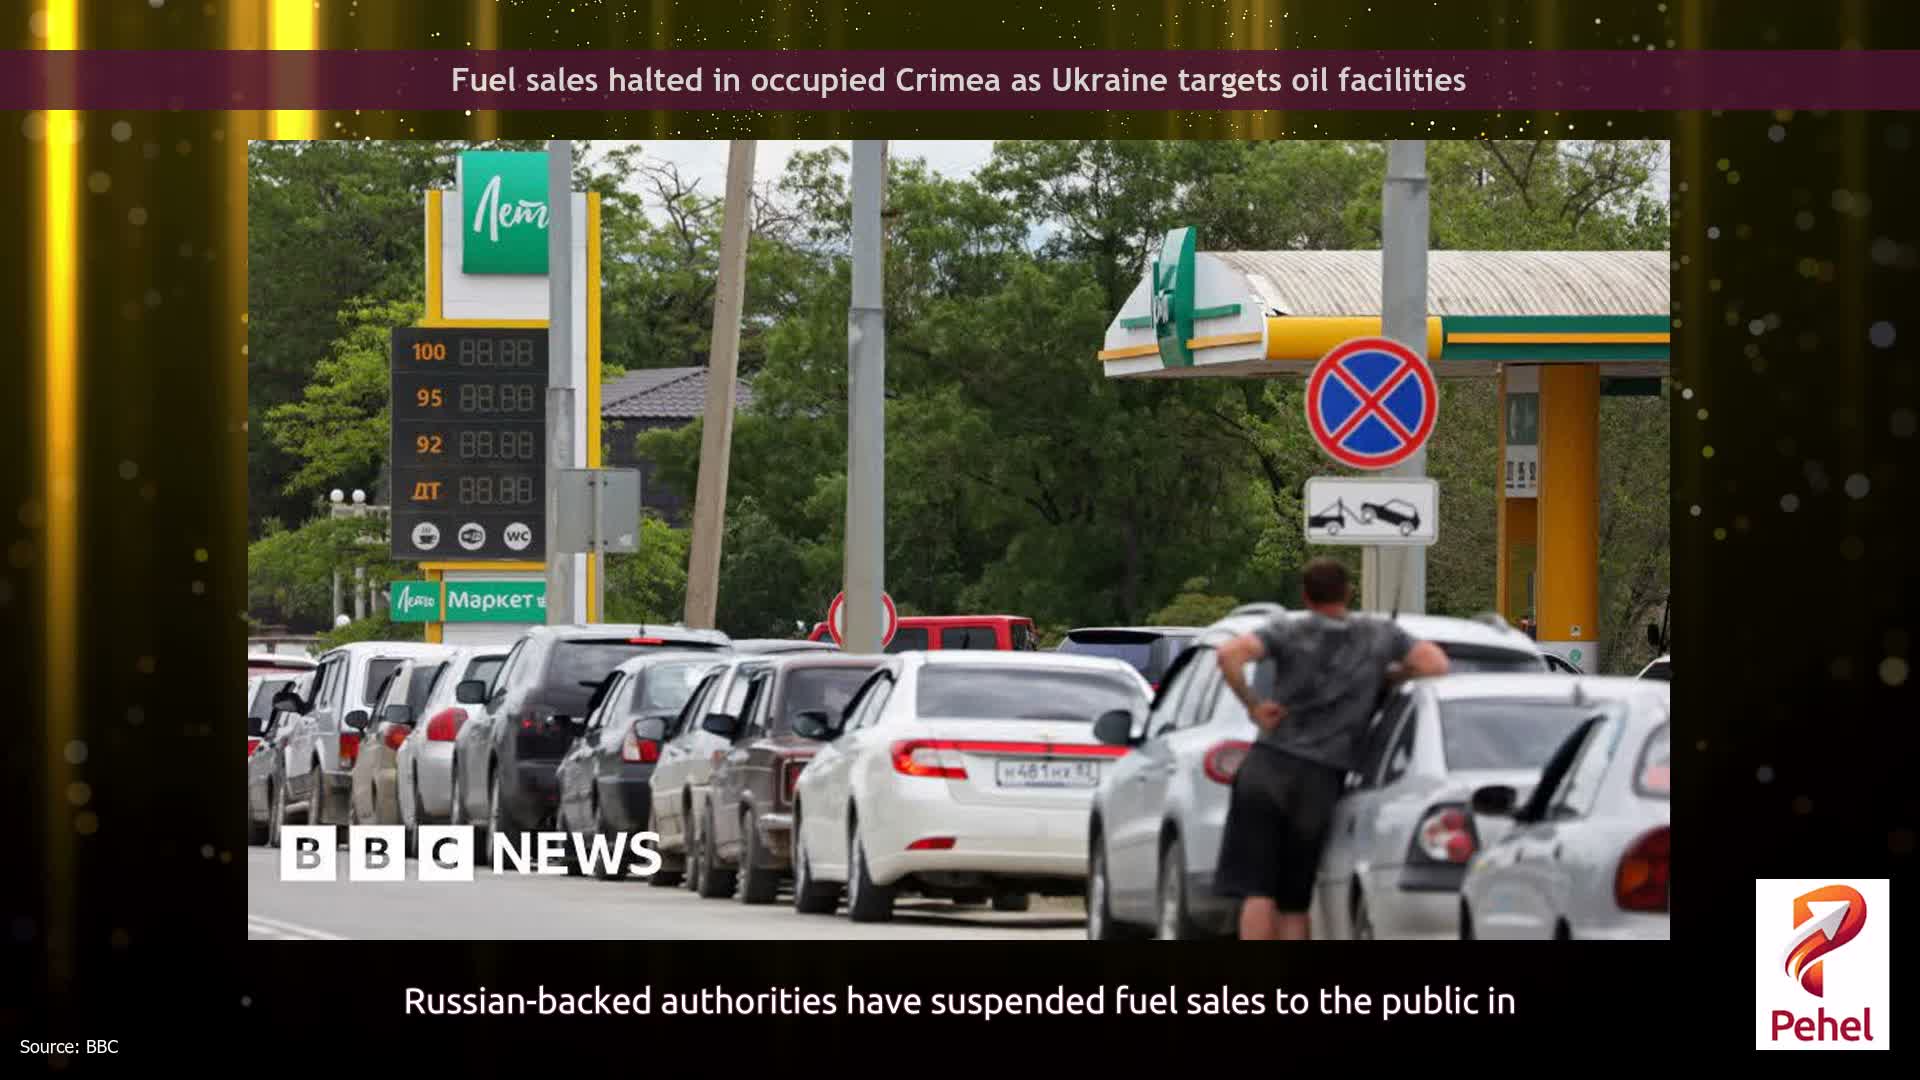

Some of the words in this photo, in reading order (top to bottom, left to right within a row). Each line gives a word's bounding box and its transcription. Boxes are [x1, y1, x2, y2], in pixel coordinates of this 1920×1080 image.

[473, 175, 551, 243] Лет
[411, 343, 446, 361] 100
[416, 388, 443, 408] 95
[416, 435, 443, 454] 92
[410, 481, 441, 501] ДТ
[506, 531, 529, 542] WC
[448, 591, 534, 613] Маркет
